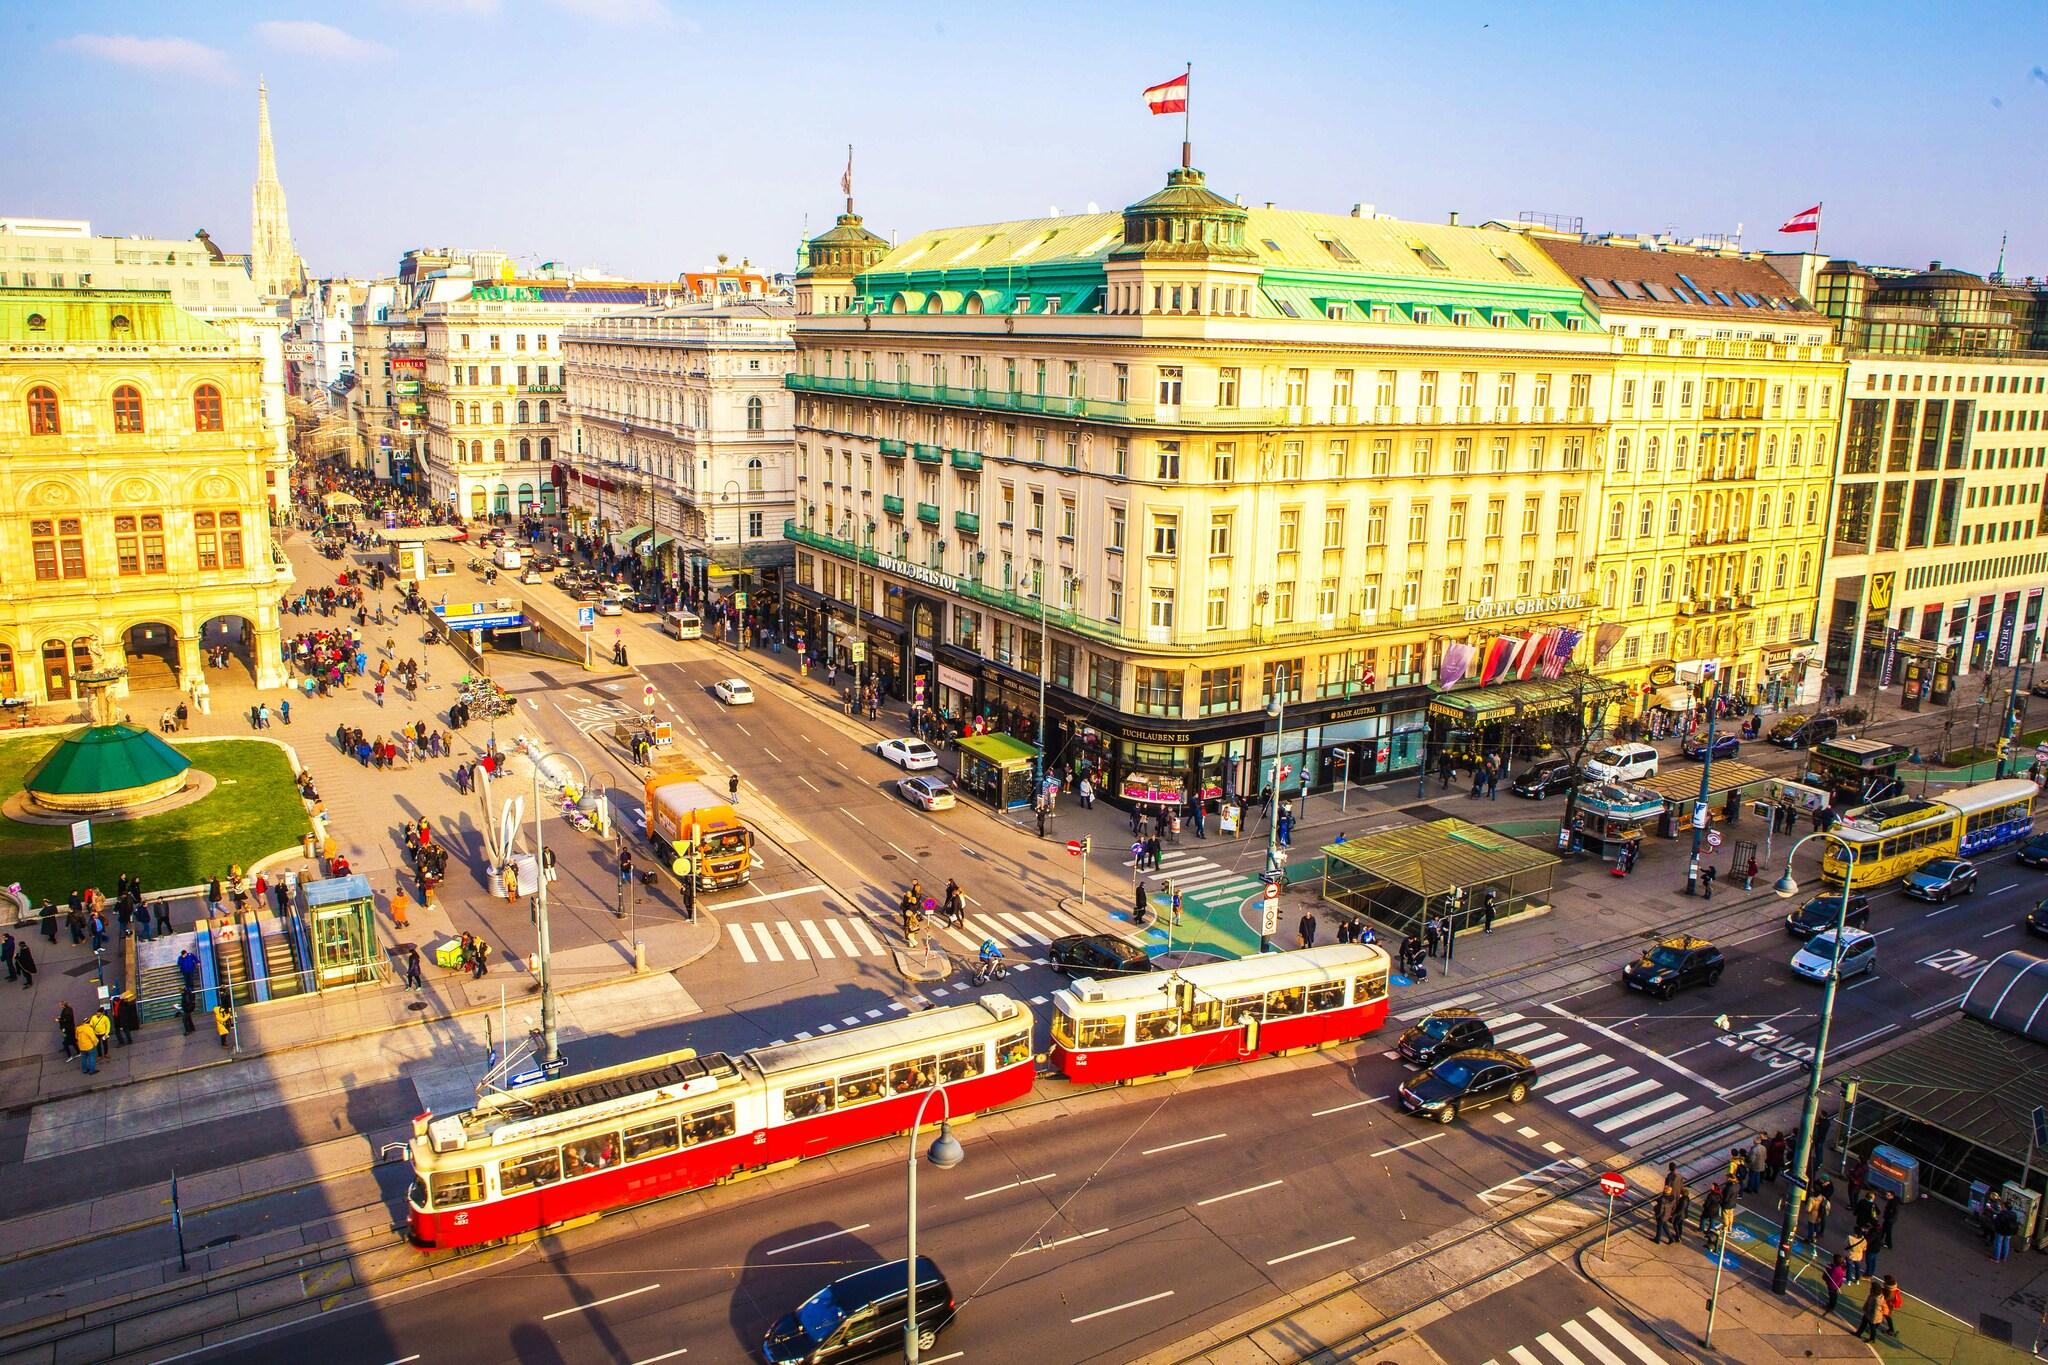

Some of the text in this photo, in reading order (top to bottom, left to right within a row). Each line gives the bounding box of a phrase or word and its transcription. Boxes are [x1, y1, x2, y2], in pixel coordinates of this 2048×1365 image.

[472, 286, 544, 301] ROLEX
[284, 343, 316, 353] CASINO
[528, 384, 562, 393] ROLEX
[878, 555, 960, 593] HOTEL BRISTOL
[1464, 594, 1585, 621] HOTEL BRISTOL
[1997, 628, 2010, 661] LASTER
[1769, 650, 1790, 663] TABAK
[1336, 706, 1377, 719] BANK AUSTRIA
[1431, 703, 1463, 719] BRISTOL
[1485, 709, 1508, 719] HOTEL
[1122, 728, 1190, 742] TUCHLAUBEN EIS
